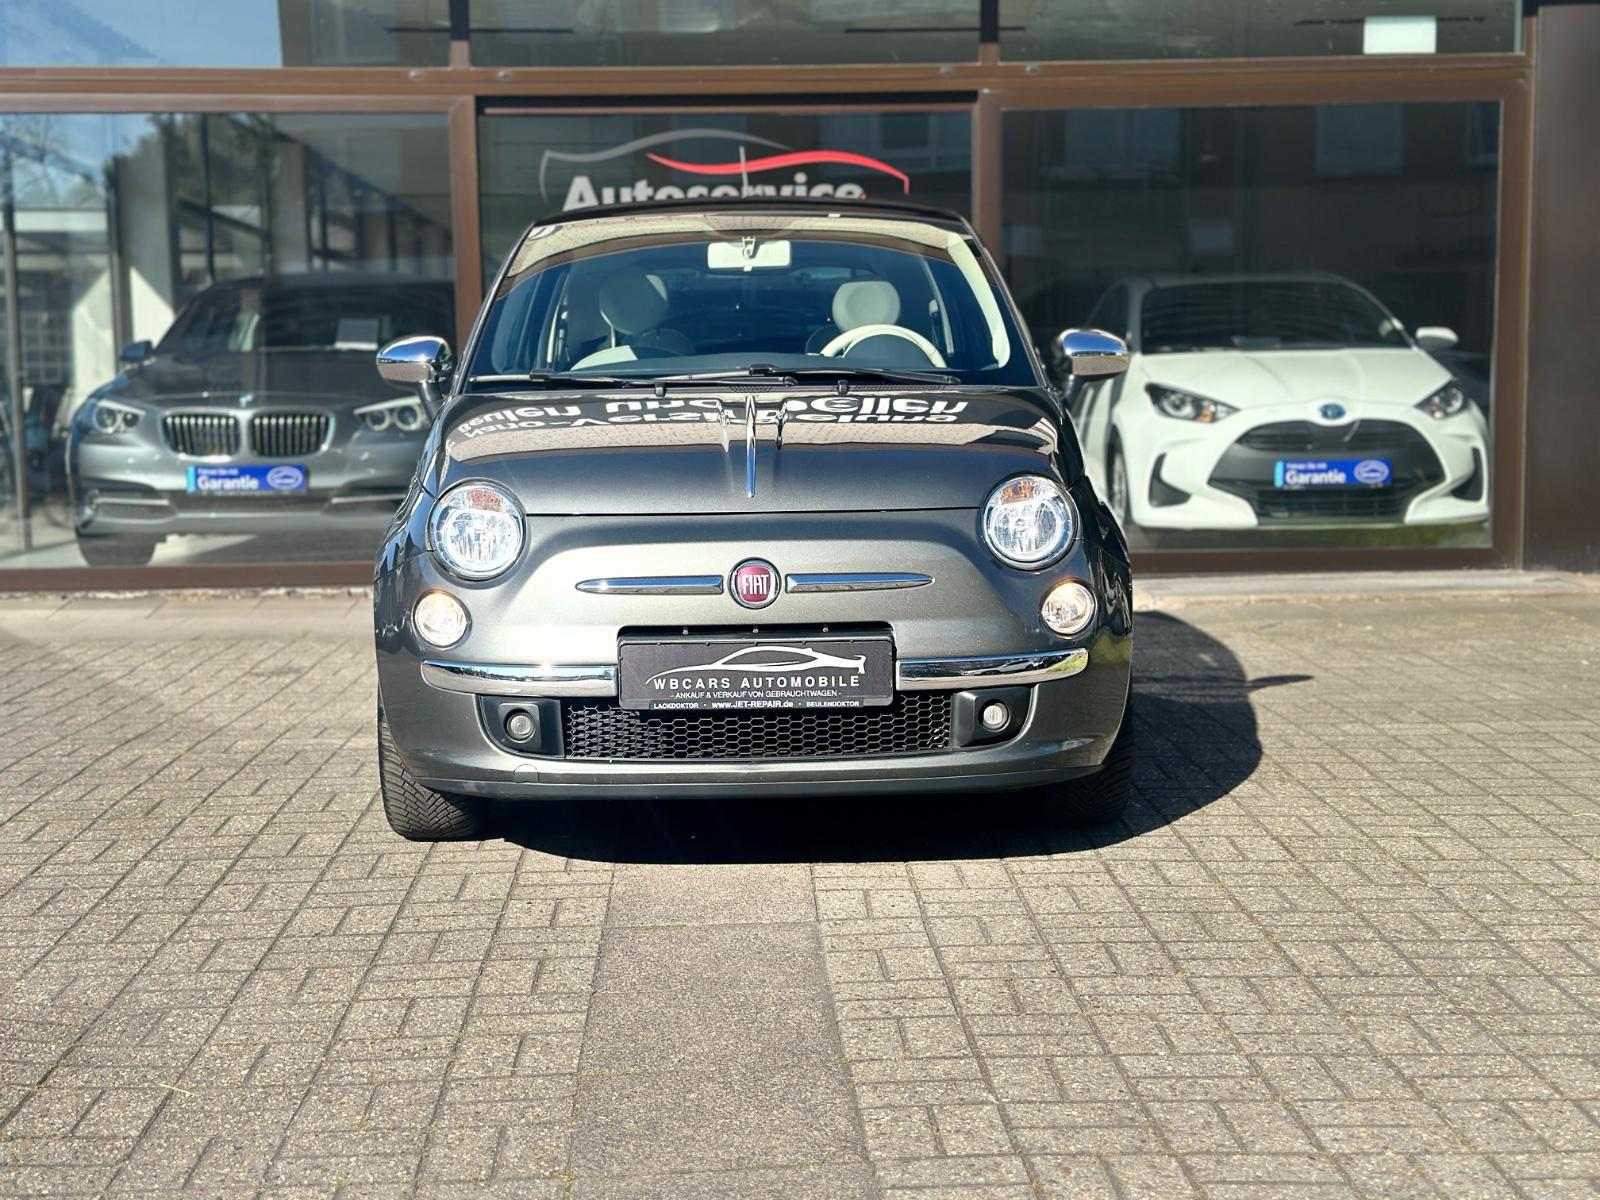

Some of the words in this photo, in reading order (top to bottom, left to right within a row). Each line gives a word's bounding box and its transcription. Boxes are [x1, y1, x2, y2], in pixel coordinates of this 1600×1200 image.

[196, 474, 259, 491] Garantie
[1285, 468, 1347, 485] Garantie
[741, 573, 769, 595] FIAT
[653, 677, 731, 690] WBCARS
[741, 675, 860, 689] AUTOMOBILE
[675, 691, 705, 699] ANKAUF
[712, 690, 747, 699] VERKAUF
[748, 690, 764, 698] VON
[765, 689, 837, 698] GEBRAUCHTWAGEN
[653, 702, 699, 710] LACKDOKTOR
[711, 700, 794, 709] www.JET-REPAIR.de
[806, 700, 860, 708] BEULENDOKTOR
